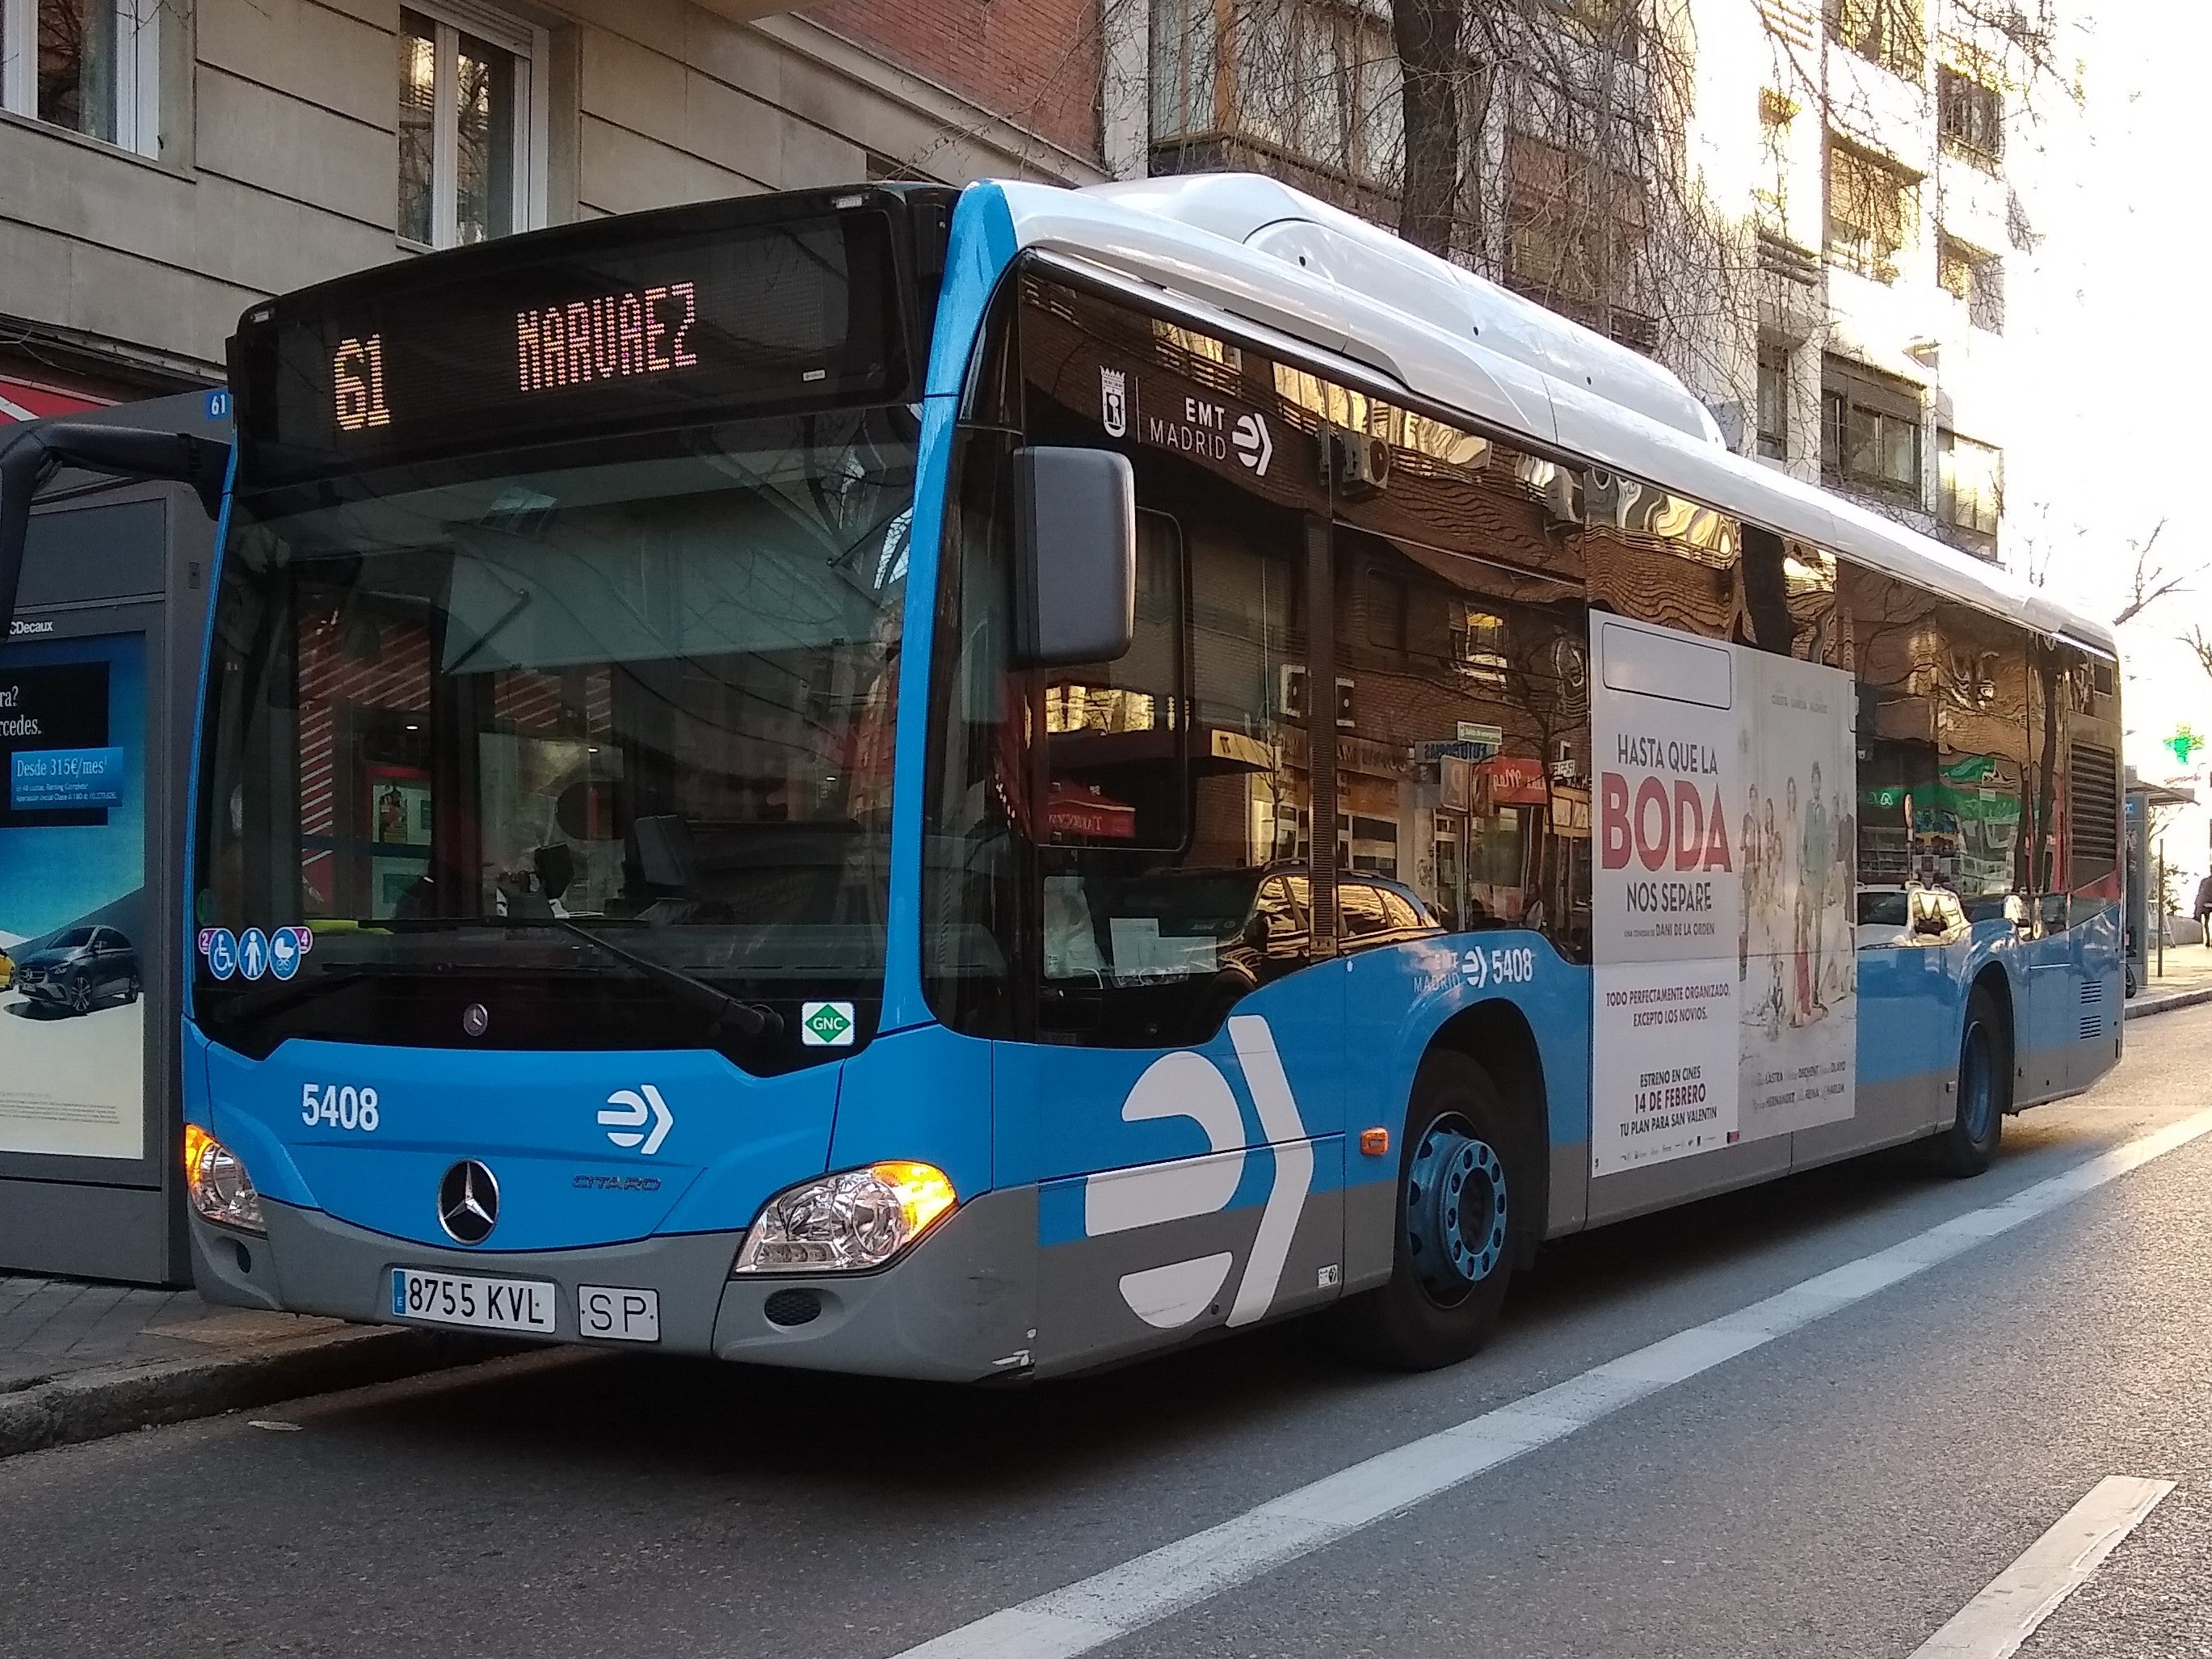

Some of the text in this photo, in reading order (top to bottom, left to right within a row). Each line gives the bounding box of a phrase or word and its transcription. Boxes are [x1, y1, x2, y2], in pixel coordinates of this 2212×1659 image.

[333, 333, 391, 431] 61
[211, 394, 225, 415] 61
[1184, 396, 1226, 431] EMT
[1150, 416, 1226, 461] MADRID
[1617, 734, 1718, 775] HASTA QUE LA
[17, 760, 47, 777] Desde
[1601, 771, 1732, 873] BODA
[1626, 882, 1712, 912] NOS SEPARE
[202, 932, 209, 946] 2
[301, 931, 309, 945] 4
[1656, 924, 1672, 937] DANI
[1674, 924, 1683, 936] DE
[1684, 923, 1693, 936] LA
[1693, 922, 1715, 936] ORDEN
[1492, 947, 1533, 984] 5408
[1414, 971, 1461, 993] MADRID
[1606, 991, 1628, 1007] TODO
[1629, 987, 1683, 1004] PERFECTAMENTE
[813, 1017, 843, 1030] GNC
[1634, 1007, 1708, 1027] EXCEPTO LOS NOVIOS.
[1640, 1065, 1701, 1088] ESTRENO EN CINES
[301, 1083, 380, 1131] 5408
[1634, 1083, 1706, 1114] 14 DE FEBRERO
[1620, 1123, 1630, 1138] TU
[1631, 1118, 1650, 1135] PLAN
[1651, 1114, 1670, 1132] PARA
[1671, 1111, 1685, 1126] SAN
[573, 1174, 662, 1190] CITARO
[409, 1278, 545, 1325] 8755 KVL
